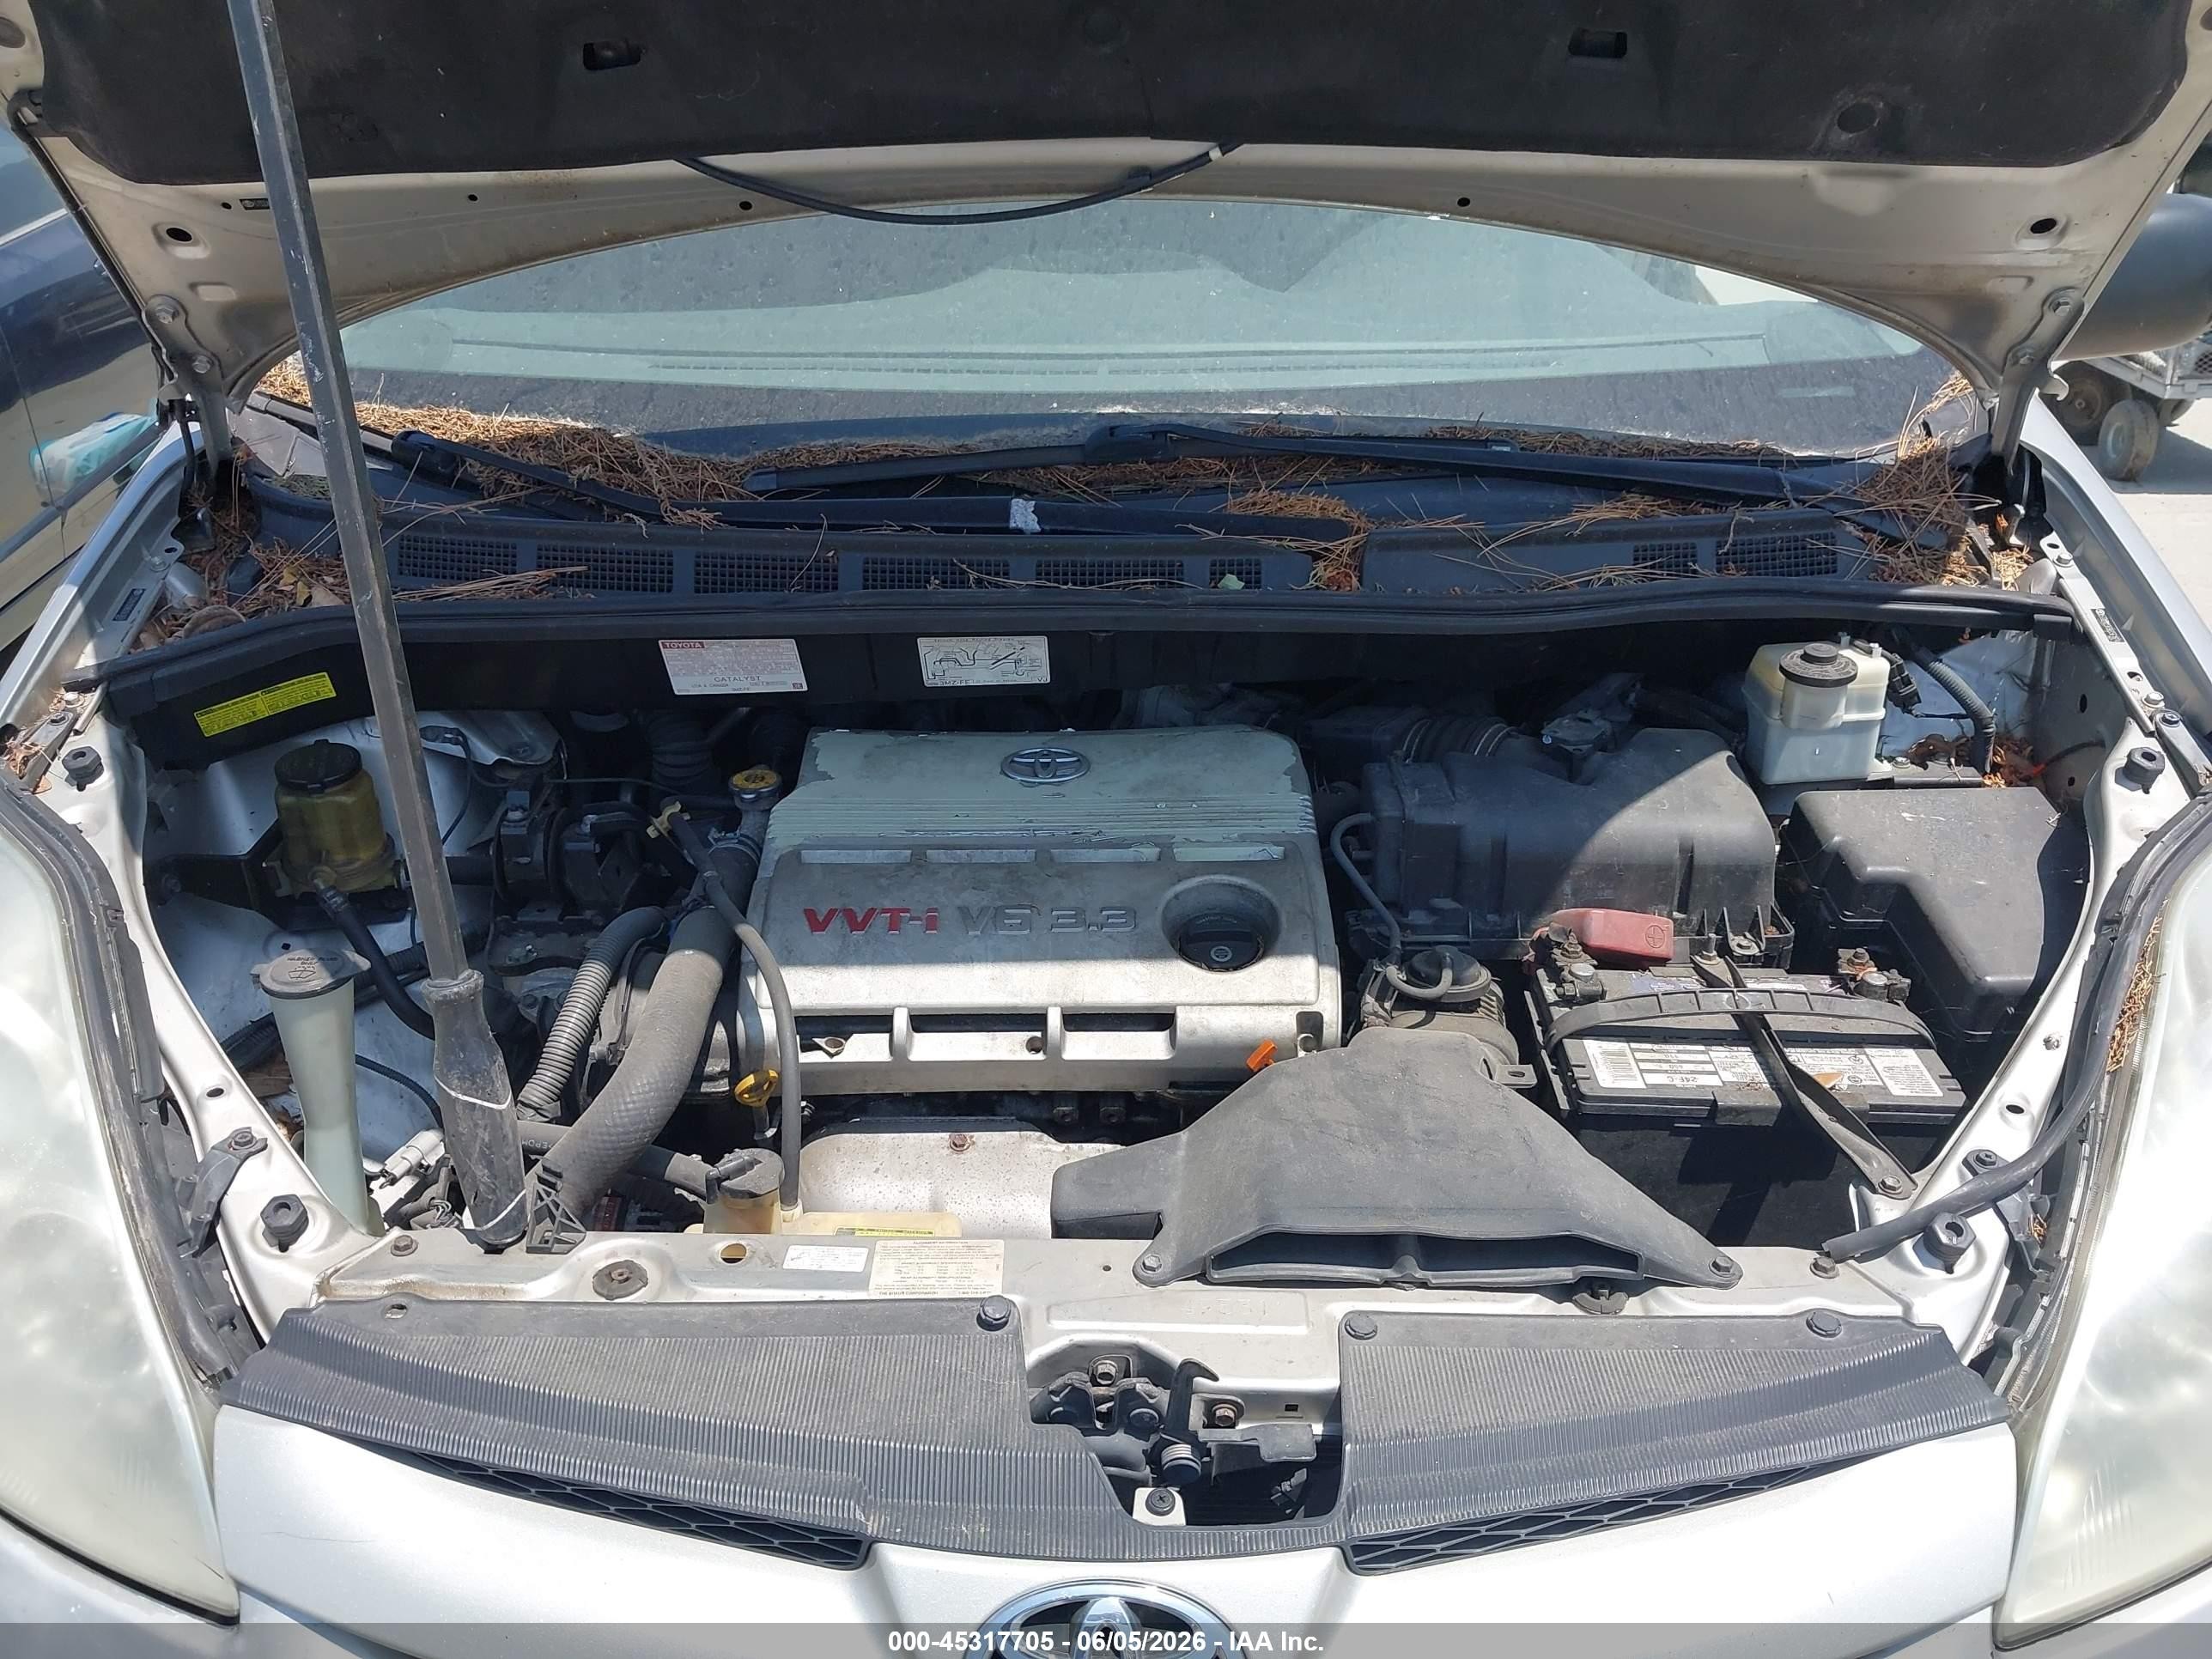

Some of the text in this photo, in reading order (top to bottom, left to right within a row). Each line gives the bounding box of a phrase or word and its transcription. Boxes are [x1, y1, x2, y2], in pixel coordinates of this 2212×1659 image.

[714, 675, 762, 684] CATALYST
[957, 905, 1033, 935] V6
[1049, 906, 1138, 933] 3.3
